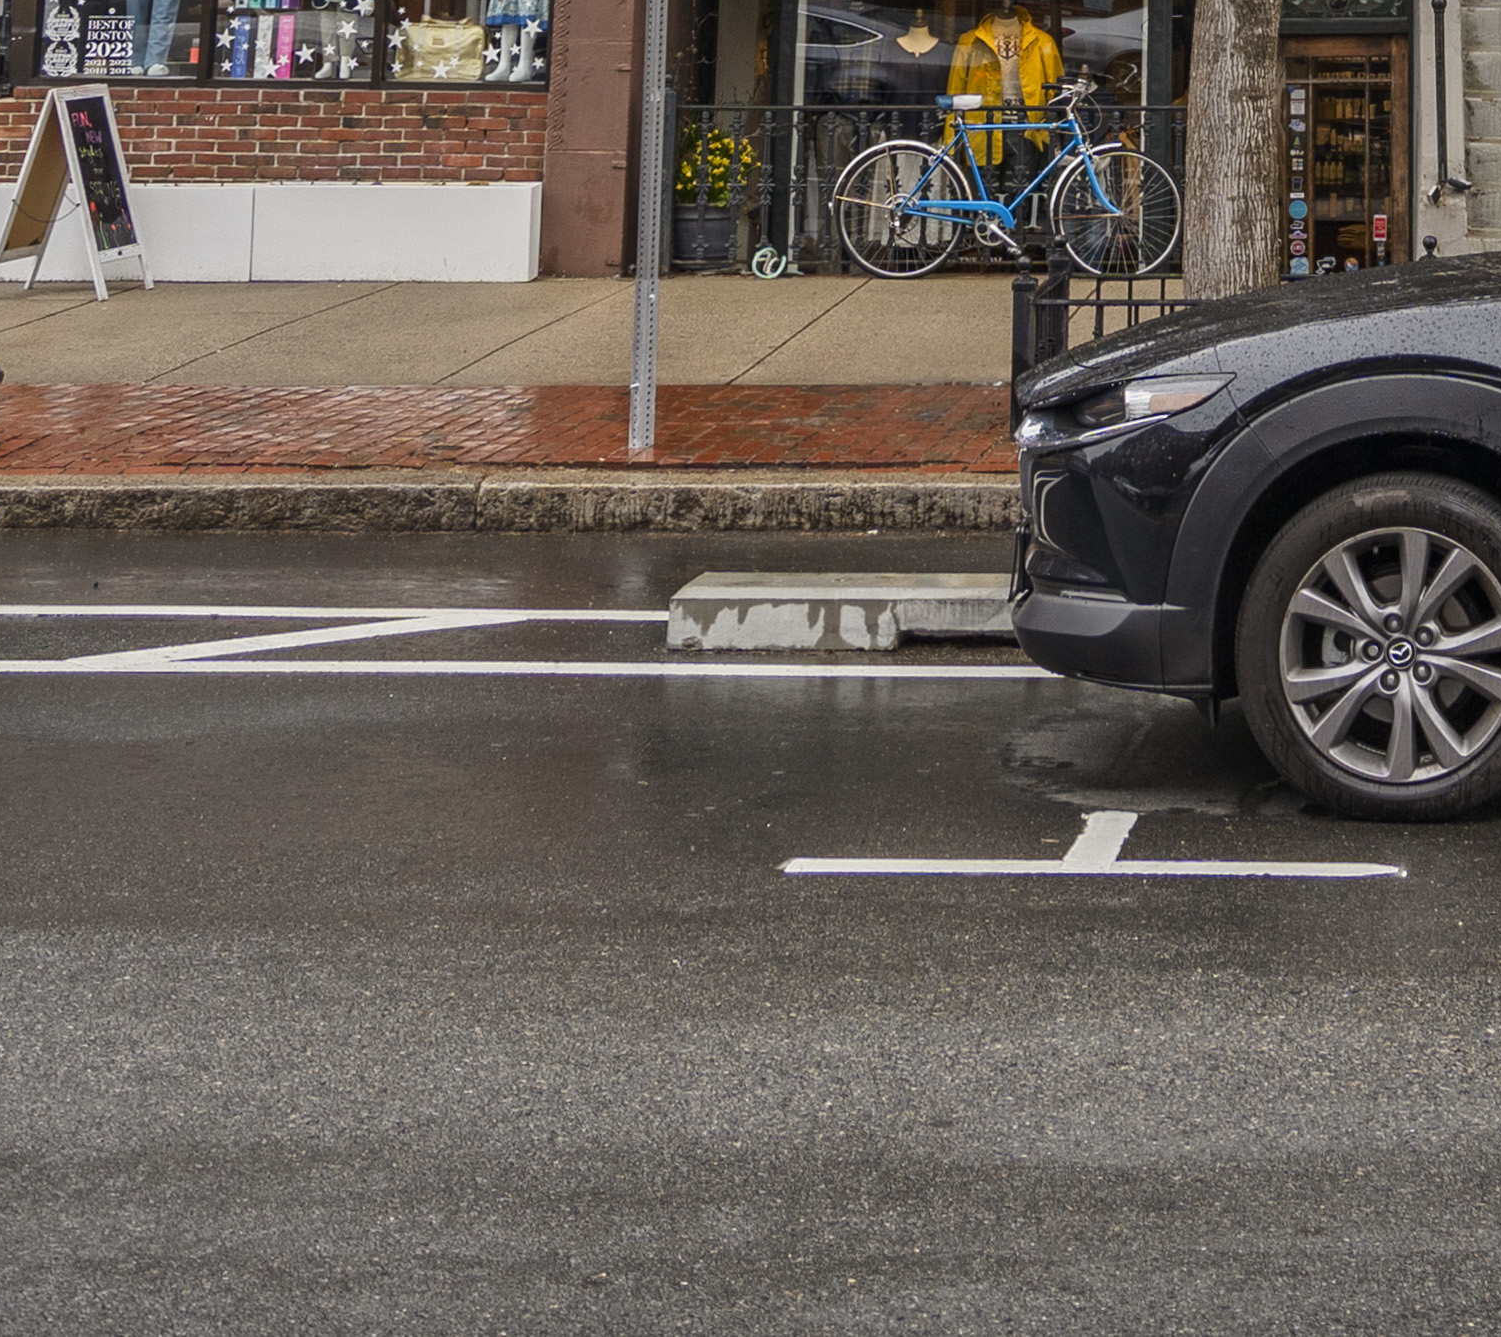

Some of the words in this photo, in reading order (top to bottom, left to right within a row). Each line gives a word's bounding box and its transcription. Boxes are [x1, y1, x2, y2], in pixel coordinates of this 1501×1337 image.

[88, 19, 119, 30] BEST
[119, 19, 135, 30] OF
[87, 30, 134, 41] BOSTON
[85, 41, 133, 58] 2023
[109, 67, 131, 75] 2017
[85, 130, 103, 144] NEW
